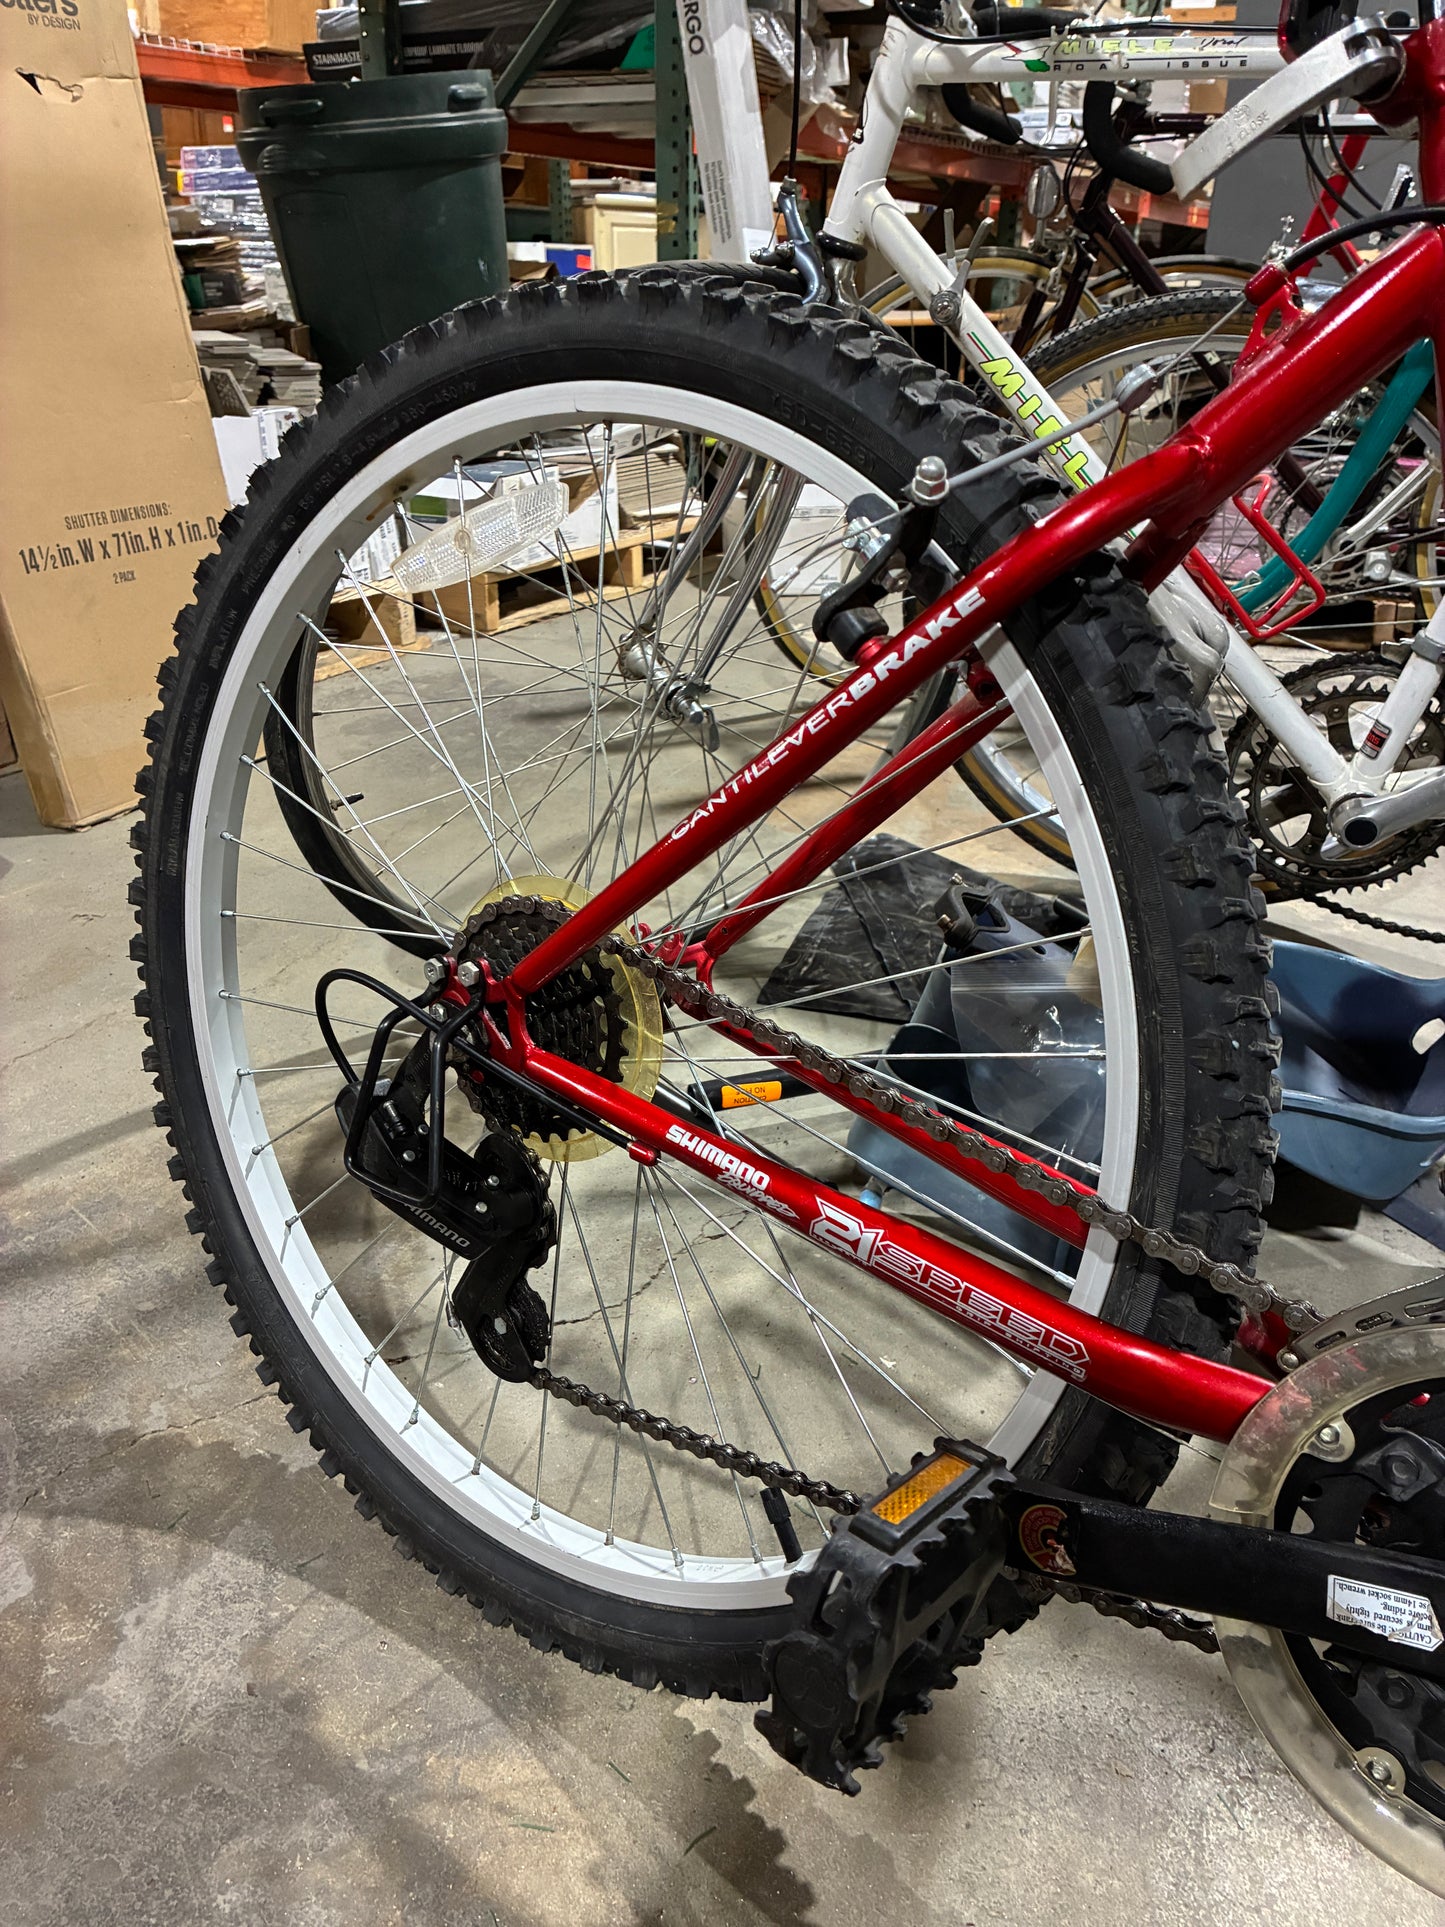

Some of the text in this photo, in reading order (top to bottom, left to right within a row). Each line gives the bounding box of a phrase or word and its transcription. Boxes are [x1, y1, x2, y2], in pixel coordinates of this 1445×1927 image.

[27, 14, 81, 30] BY DESIGN
[683, 0, 705, 55] RGO
[1053, 38, 1174, 55] MIELE
[312, 51, 361, 66] STAINMASTE
[1166, 59, 1247, 69] ISSUE
[979, 356, 1089, 490] MIEL
[64, 502, 173, 531] SHUTTER DIMENSIONS:
[98, 539, 111, 560] x
[165, 528, 176, 547] x
[112, 570, 136, 585] 2 PACK
[754, 1086, 766, 1094] NO
[733, 1095, 767, 1105] CTION
[665, 1124, 770, 1191] SHIMANO
[403, 1203, 471, 1247] IMANO
[809, 1195, 1091, 1365] 21 SPEED
[1336, 1581, 1366, 1596] wrench.
[1367, 1589, 1392, 1601] socket
[1393, 1595, 1416, 1608] 14mm
[1345, 1603, 1370, 1619] tightly
[1380, 1601, 1406, 1618] riding.
[1336, 1613, 1356, 1624] rank
[1373, 1612, 1403, 1625] secured
[1376, 1623, 1387, 1634] Be
[1417, 1622, 1433, 1632] arm
